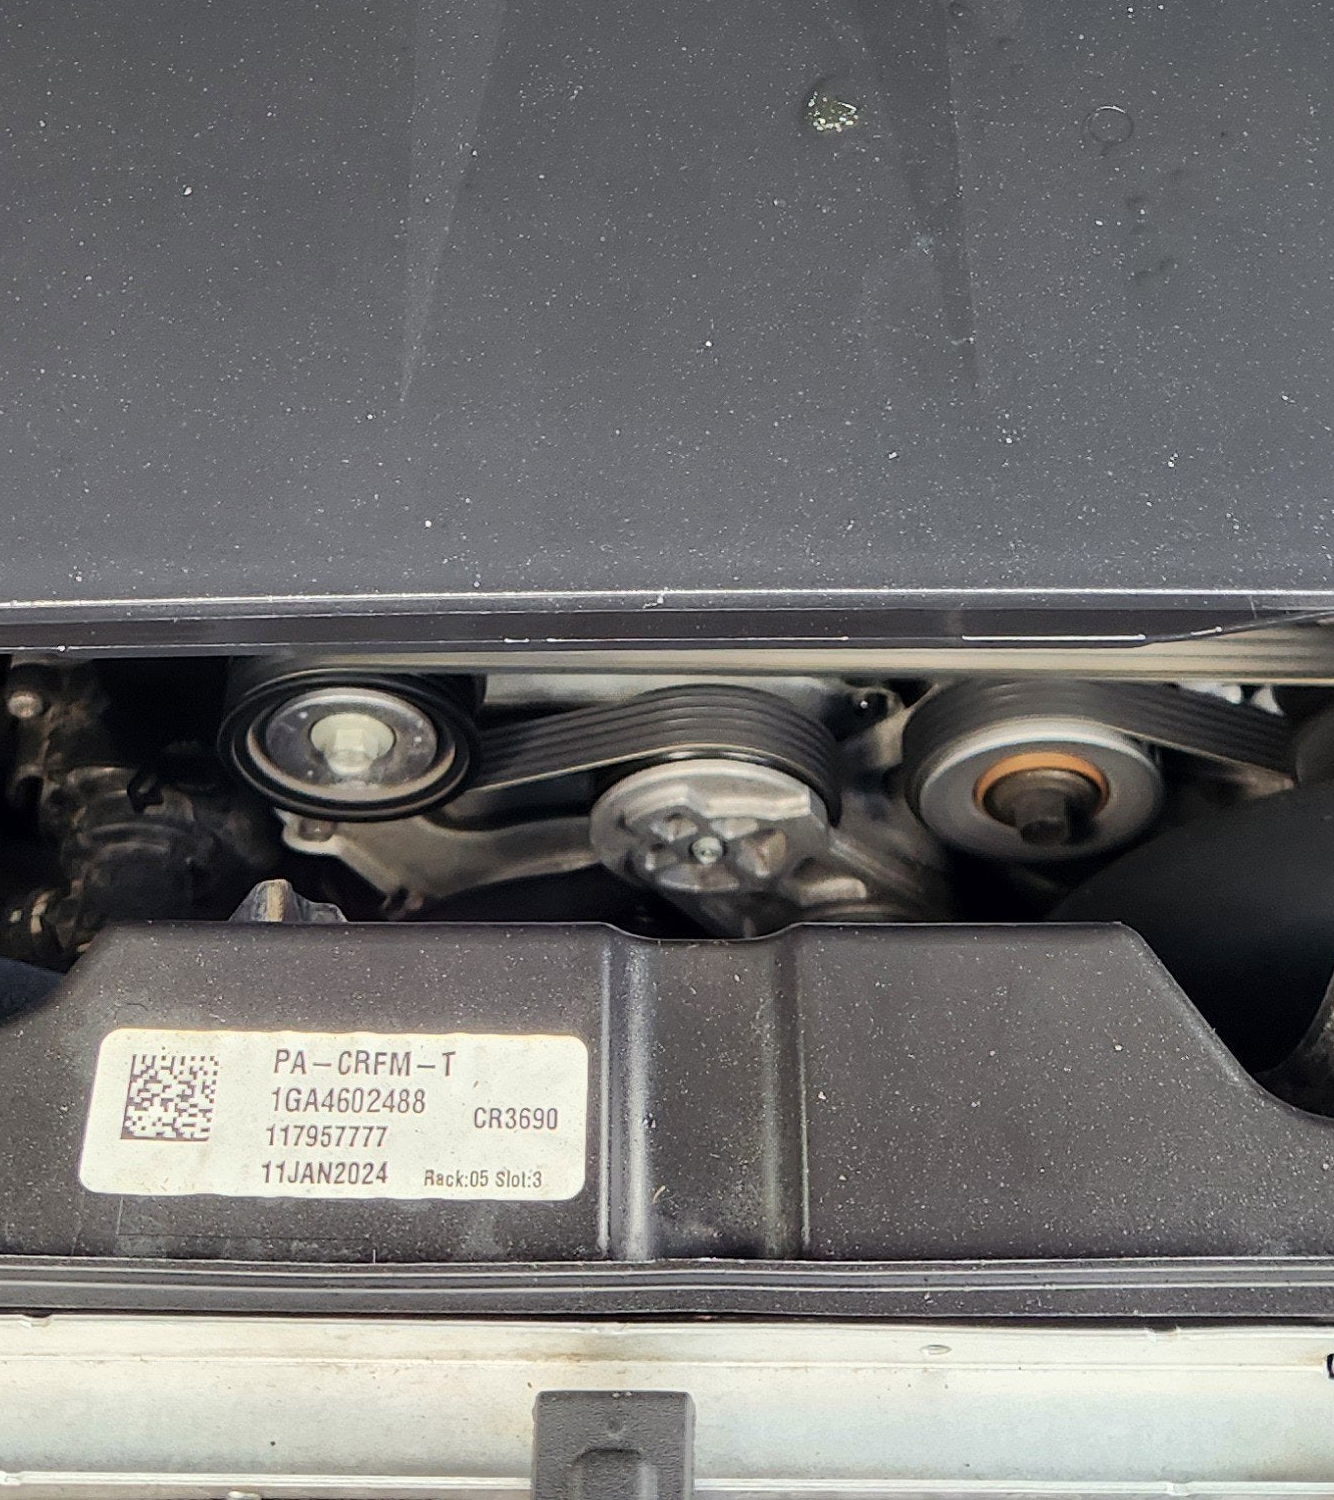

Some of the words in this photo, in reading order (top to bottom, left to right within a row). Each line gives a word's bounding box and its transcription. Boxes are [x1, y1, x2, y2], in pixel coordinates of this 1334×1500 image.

[273, 1049, 456, 1077] PA-CRFM-T
[271, 1086, 426, 1114] 1GA4602488
[474, 1107, 558, 1130] CR3690
[266, 1124, 389, 1147] 117957777
[261, 1160, 389, 1185] 11JAN2024
[424, 1169, 489, 1188] Rack:05
[495, 1169, 542, 1188] Slot:3
